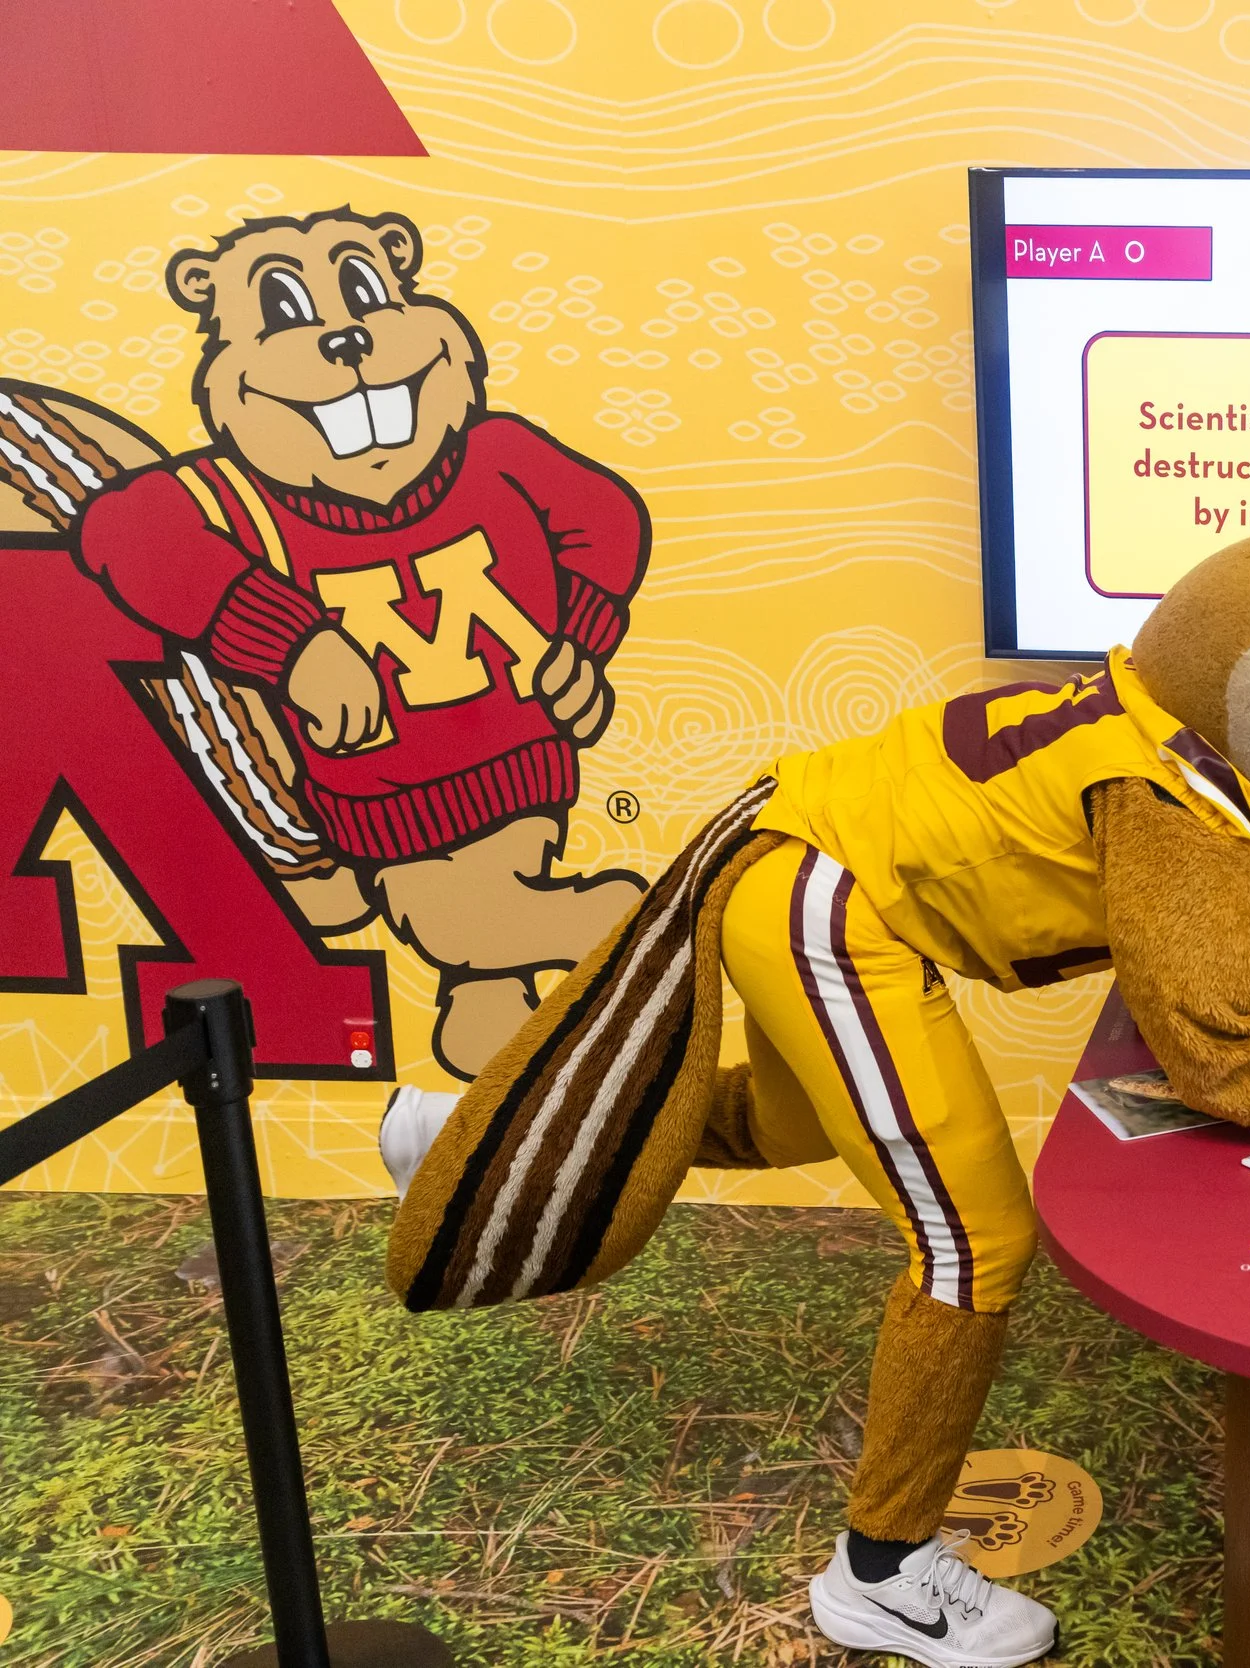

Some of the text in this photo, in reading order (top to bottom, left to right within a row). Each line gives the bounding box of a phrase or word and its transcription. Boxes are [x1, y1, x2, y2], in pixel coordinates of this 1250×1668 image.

[1013, 239, 1081, 267] Player
[1088, 241, 1105, 262] A
[1194, 496, 1230, 534] by
[1046, 1480, 1085, 1549] Game time!
